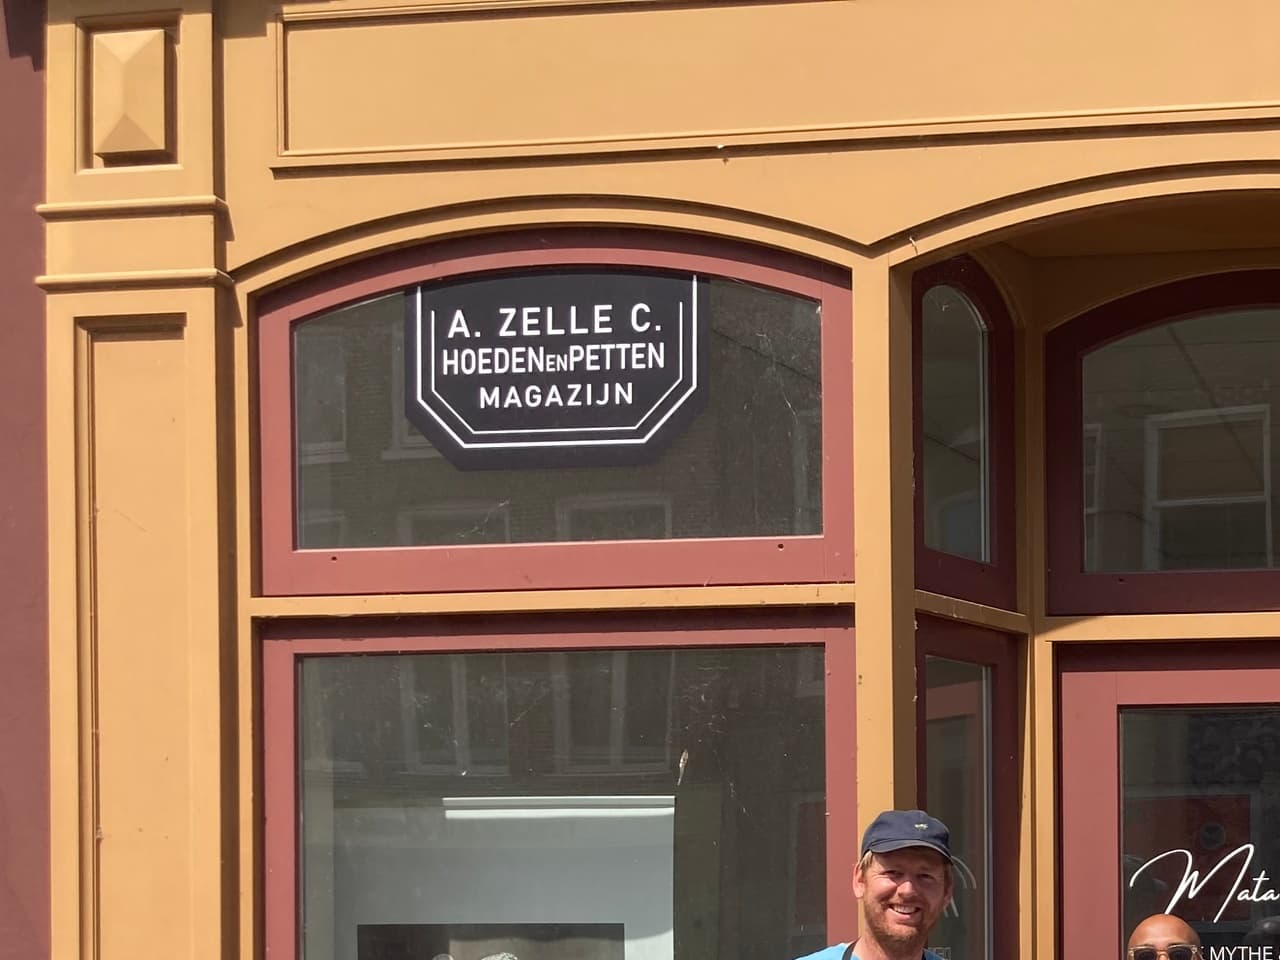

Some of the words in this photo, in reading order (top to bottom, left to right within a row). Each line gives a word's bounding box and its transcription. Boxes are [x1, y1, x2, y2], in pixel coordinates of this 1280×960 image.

[448, 310, 481, 338] A.
[499, 304, 612, 336] ZELLE
[631, 303, 661, 332] C.
[480, 382, 633, 408] MAGAZIJN
